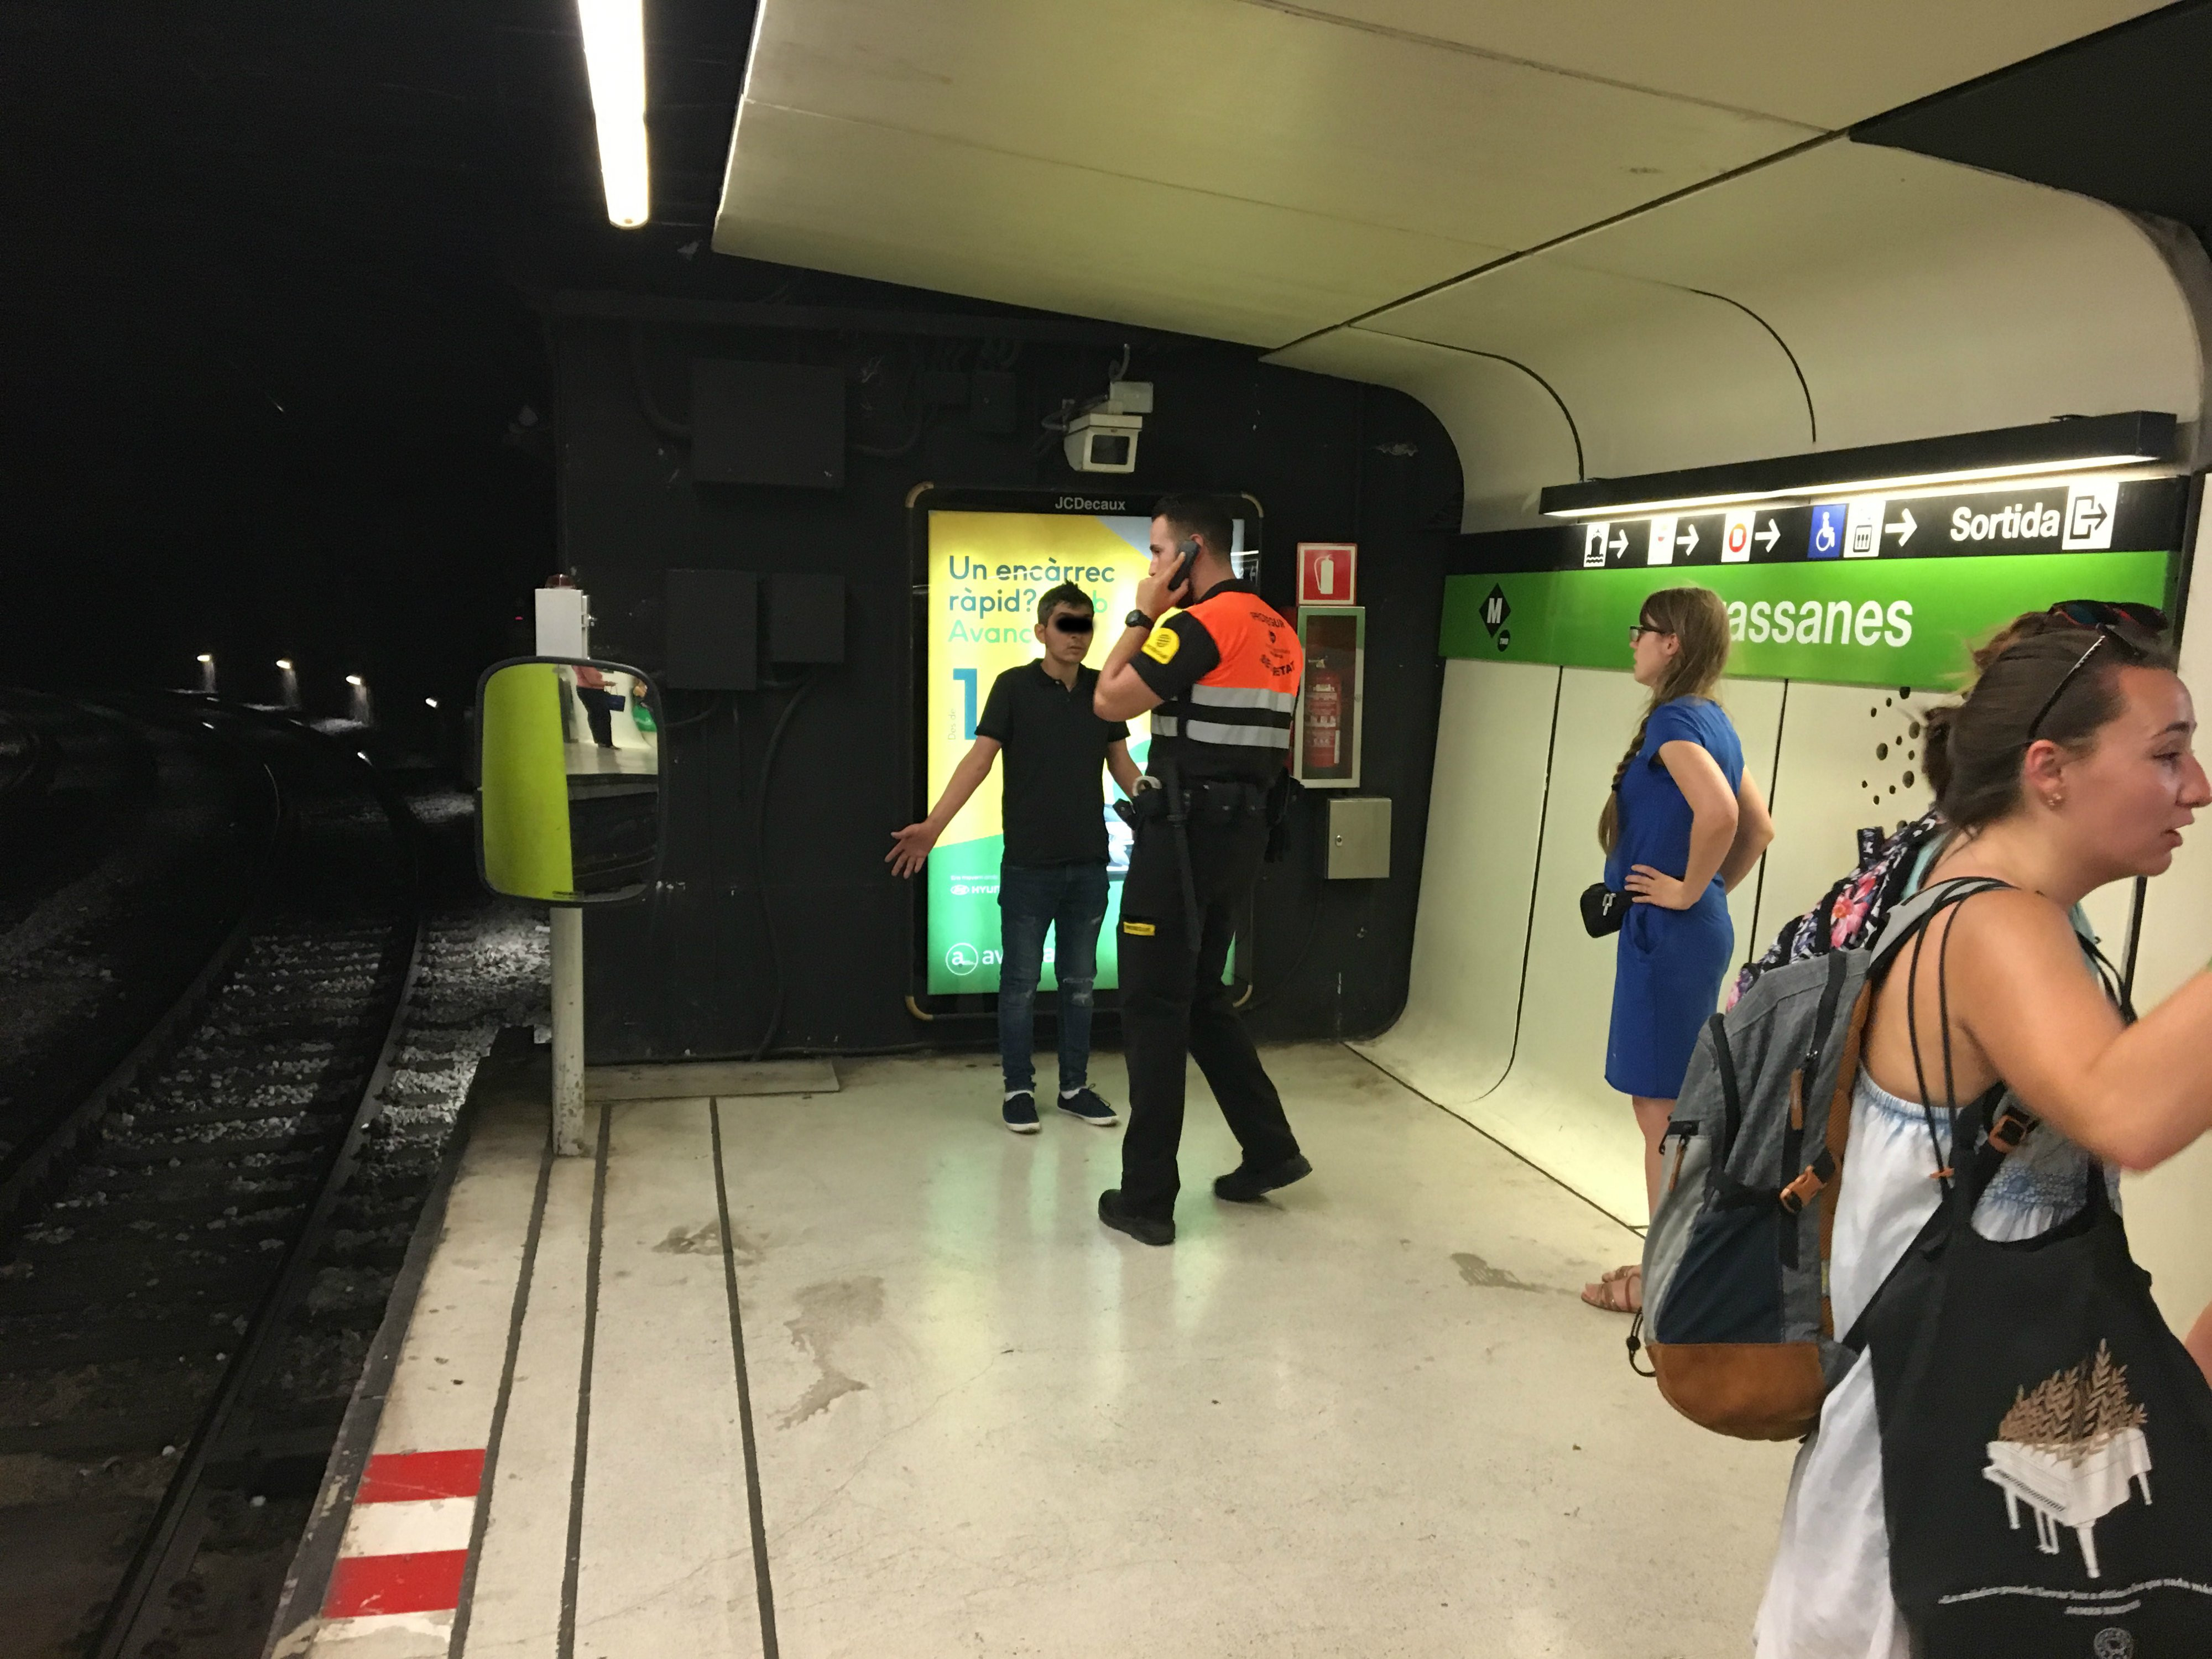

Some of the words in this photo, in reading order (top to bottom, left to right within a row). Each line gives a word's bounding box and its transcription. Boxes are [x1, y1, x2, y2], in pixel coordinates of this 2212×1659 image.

[1055, 497, 1126, 510] JCDecaux
[1950, 502, 2060, 542] Sortida
[949, 555, 987, 580] Un
[996, 556, 1115, 582] encàrrec
[949, 587, 1037, 619] ràpid?
[947, 619, 1033, 644] Avanc
[1723, 600, 1913, 648] assanes
[948, 708, 956, 720] de
[947, 723, 956, 740] Des
[972, 885, 1000, 894] HYUN
